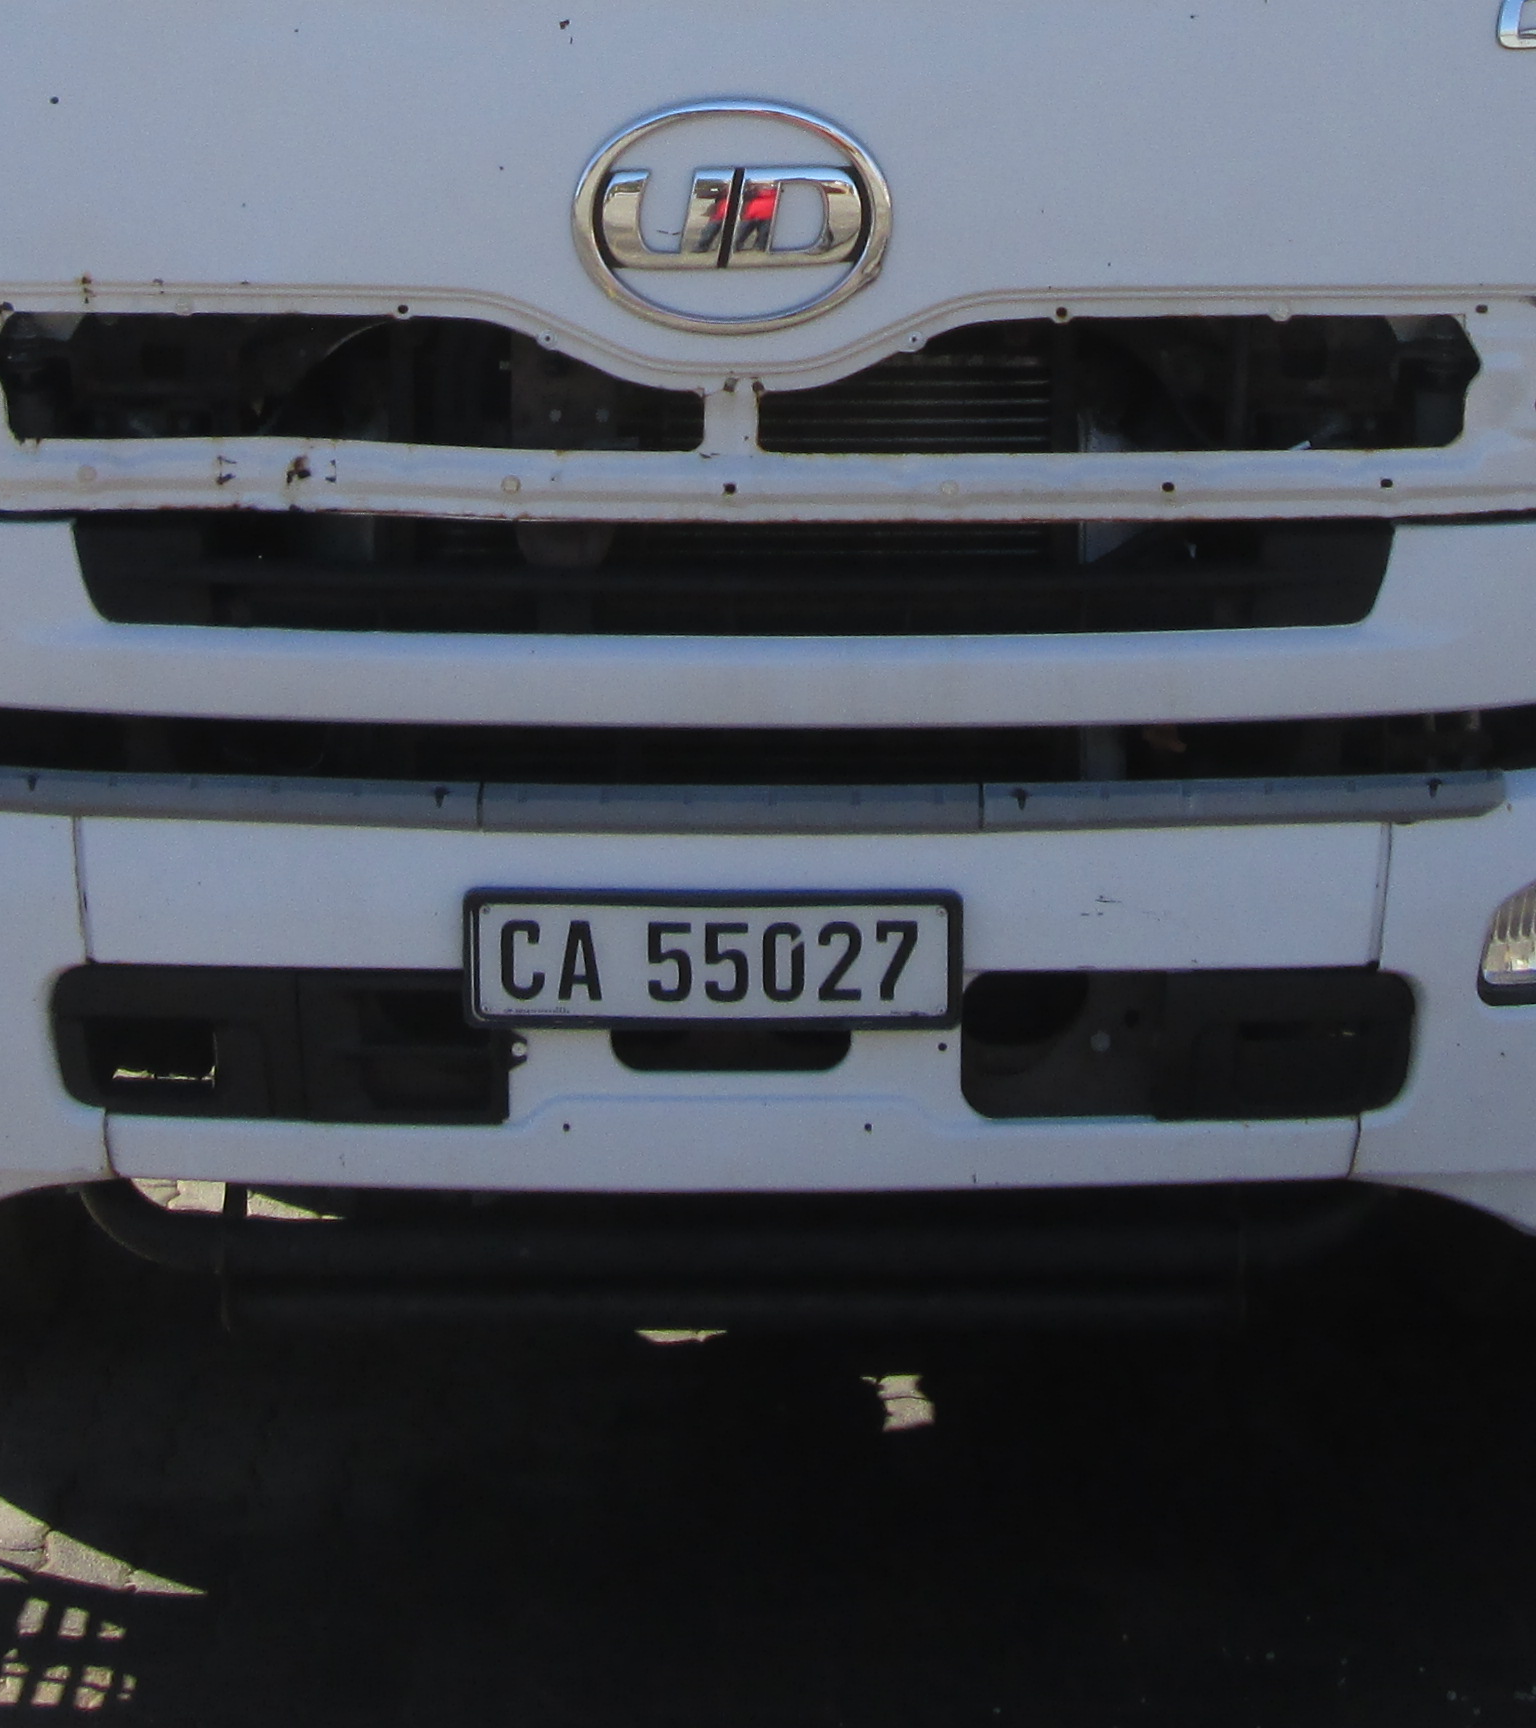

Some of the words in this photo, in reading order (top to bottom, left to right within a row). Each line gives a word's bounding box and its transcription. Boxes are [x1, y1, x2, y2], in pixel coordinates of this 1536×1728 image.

[601, 166, 863, 270] UD
[499, 919, 603, 1001] CA
[647, 921, 919, 1003] 55027
